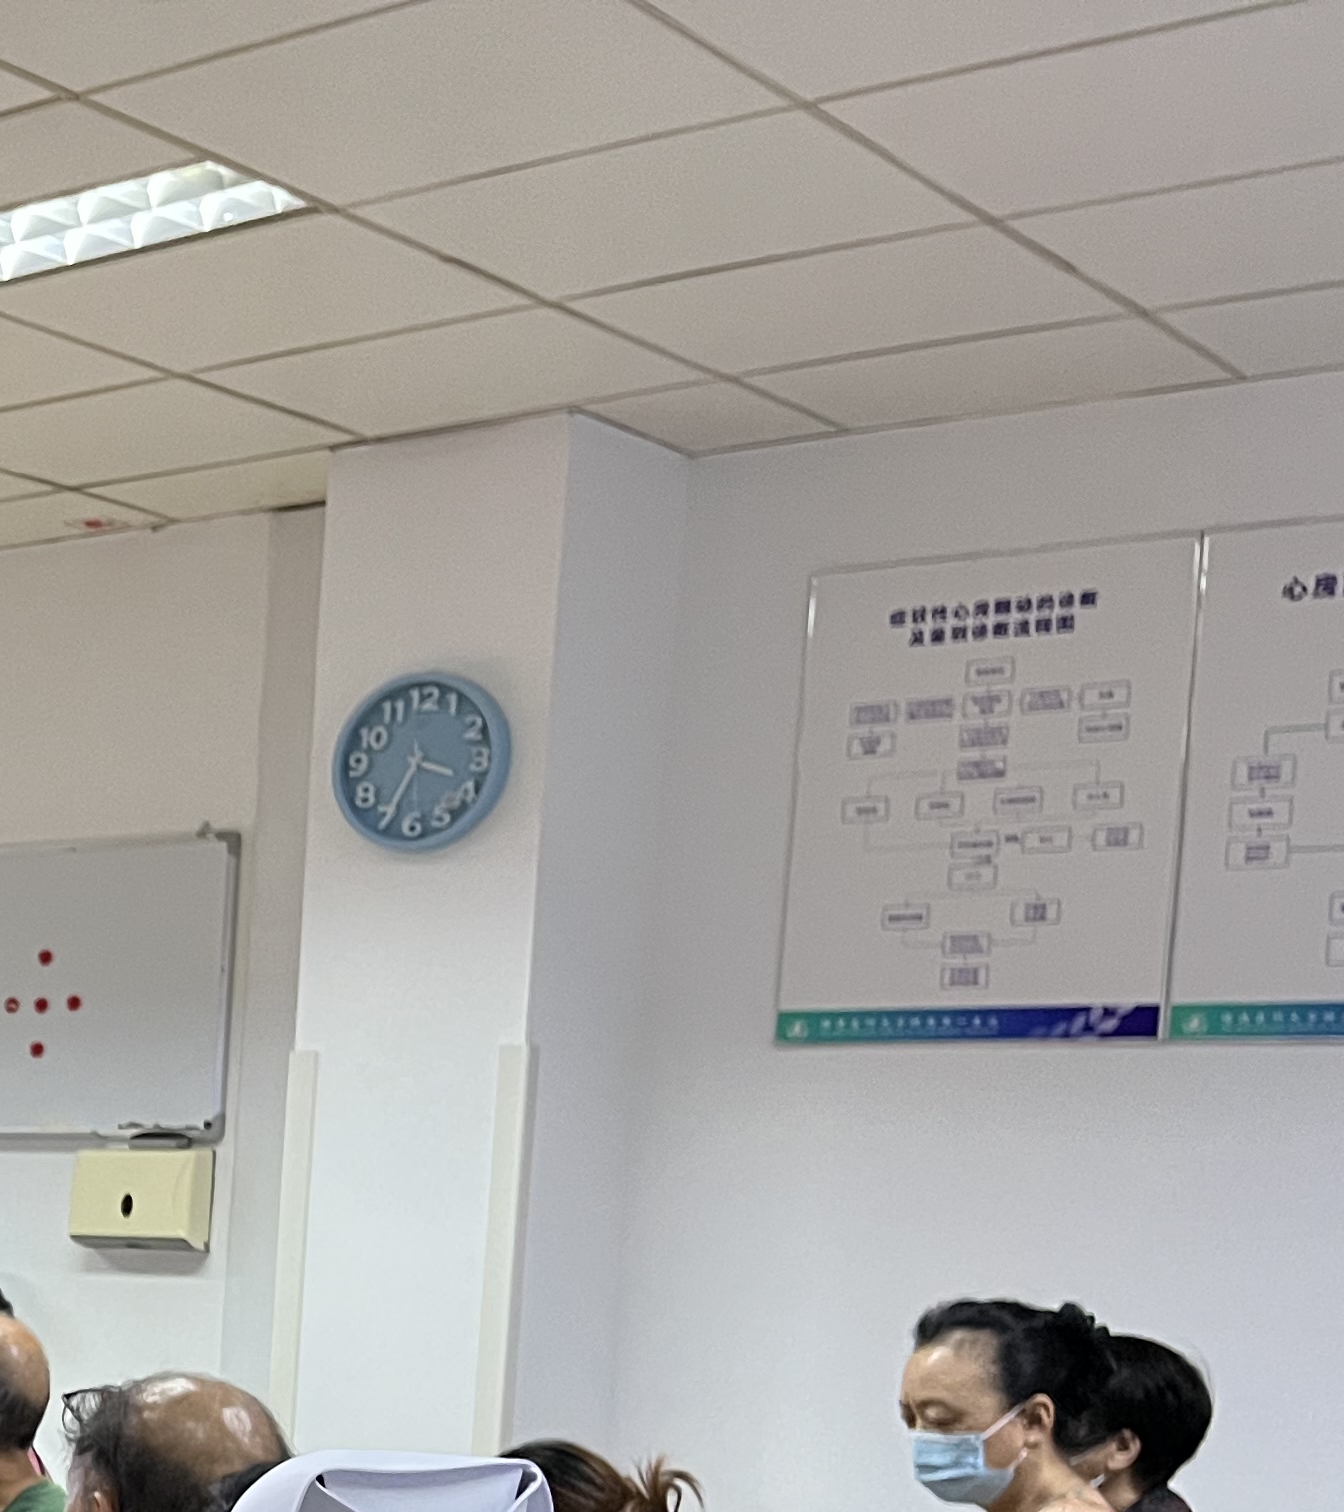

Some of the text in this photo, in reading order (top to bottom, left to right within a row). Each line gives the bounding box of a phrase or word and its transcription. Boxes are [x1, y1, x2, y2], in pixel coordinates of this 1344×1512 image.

[1281, 575, 1344, 602] 心房
[409, 685, 440, 711] 12
[446, 692, 459, 717] 1
[382, 700, 405, 724] 11
[360, 725, 388, 751] 10
[464, 714, 483, 741] 2
[348, 751, 369, 778] 9
[469, 746, 489, 772] 3
[354, 780, 376, 809] 8
[459, 778, 476, 804] 4
[401, 811, 422, 838] 6
[430, 804, 451, 828] 5
